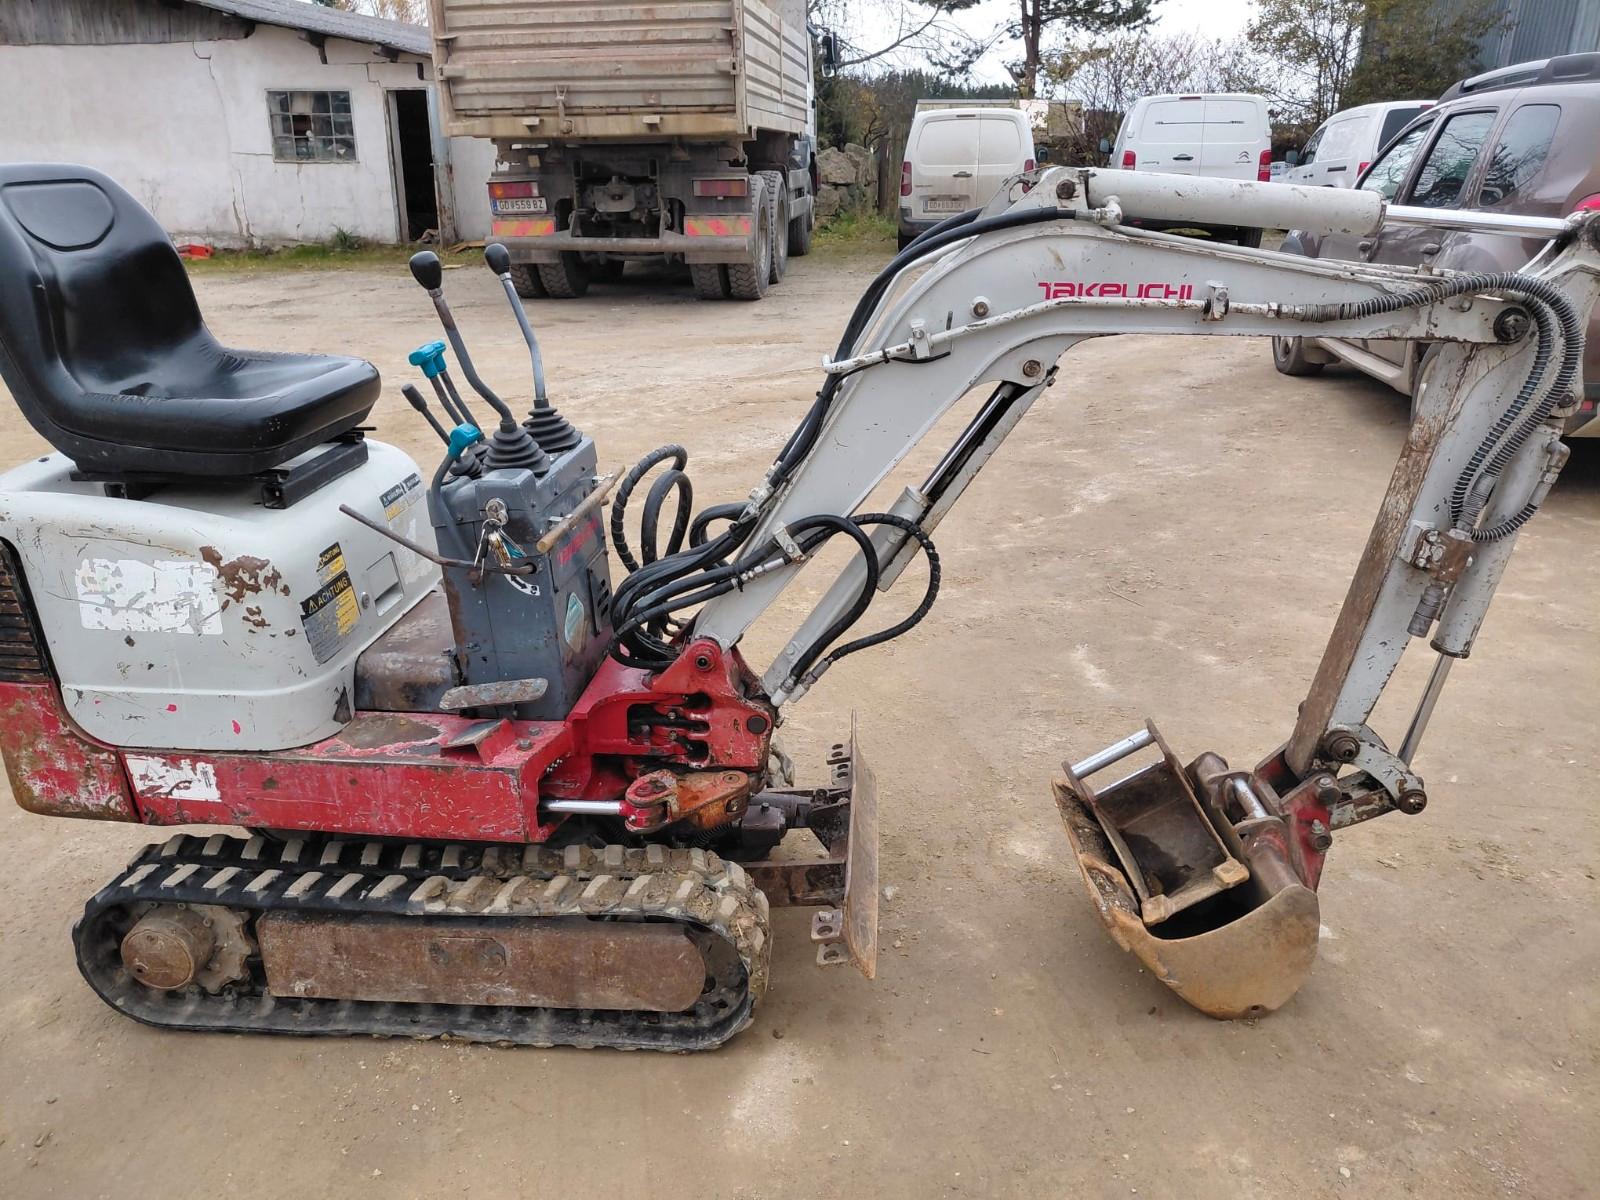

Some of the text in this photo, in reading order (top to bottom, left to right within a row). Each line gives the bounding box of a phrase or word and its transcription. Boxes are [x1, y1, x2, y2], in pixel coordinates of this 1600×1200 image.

[499, 200, 510, 209] GD
[532, 199, 543, 209] BZ
[318, 576, 348, 604] ACHTUNG
